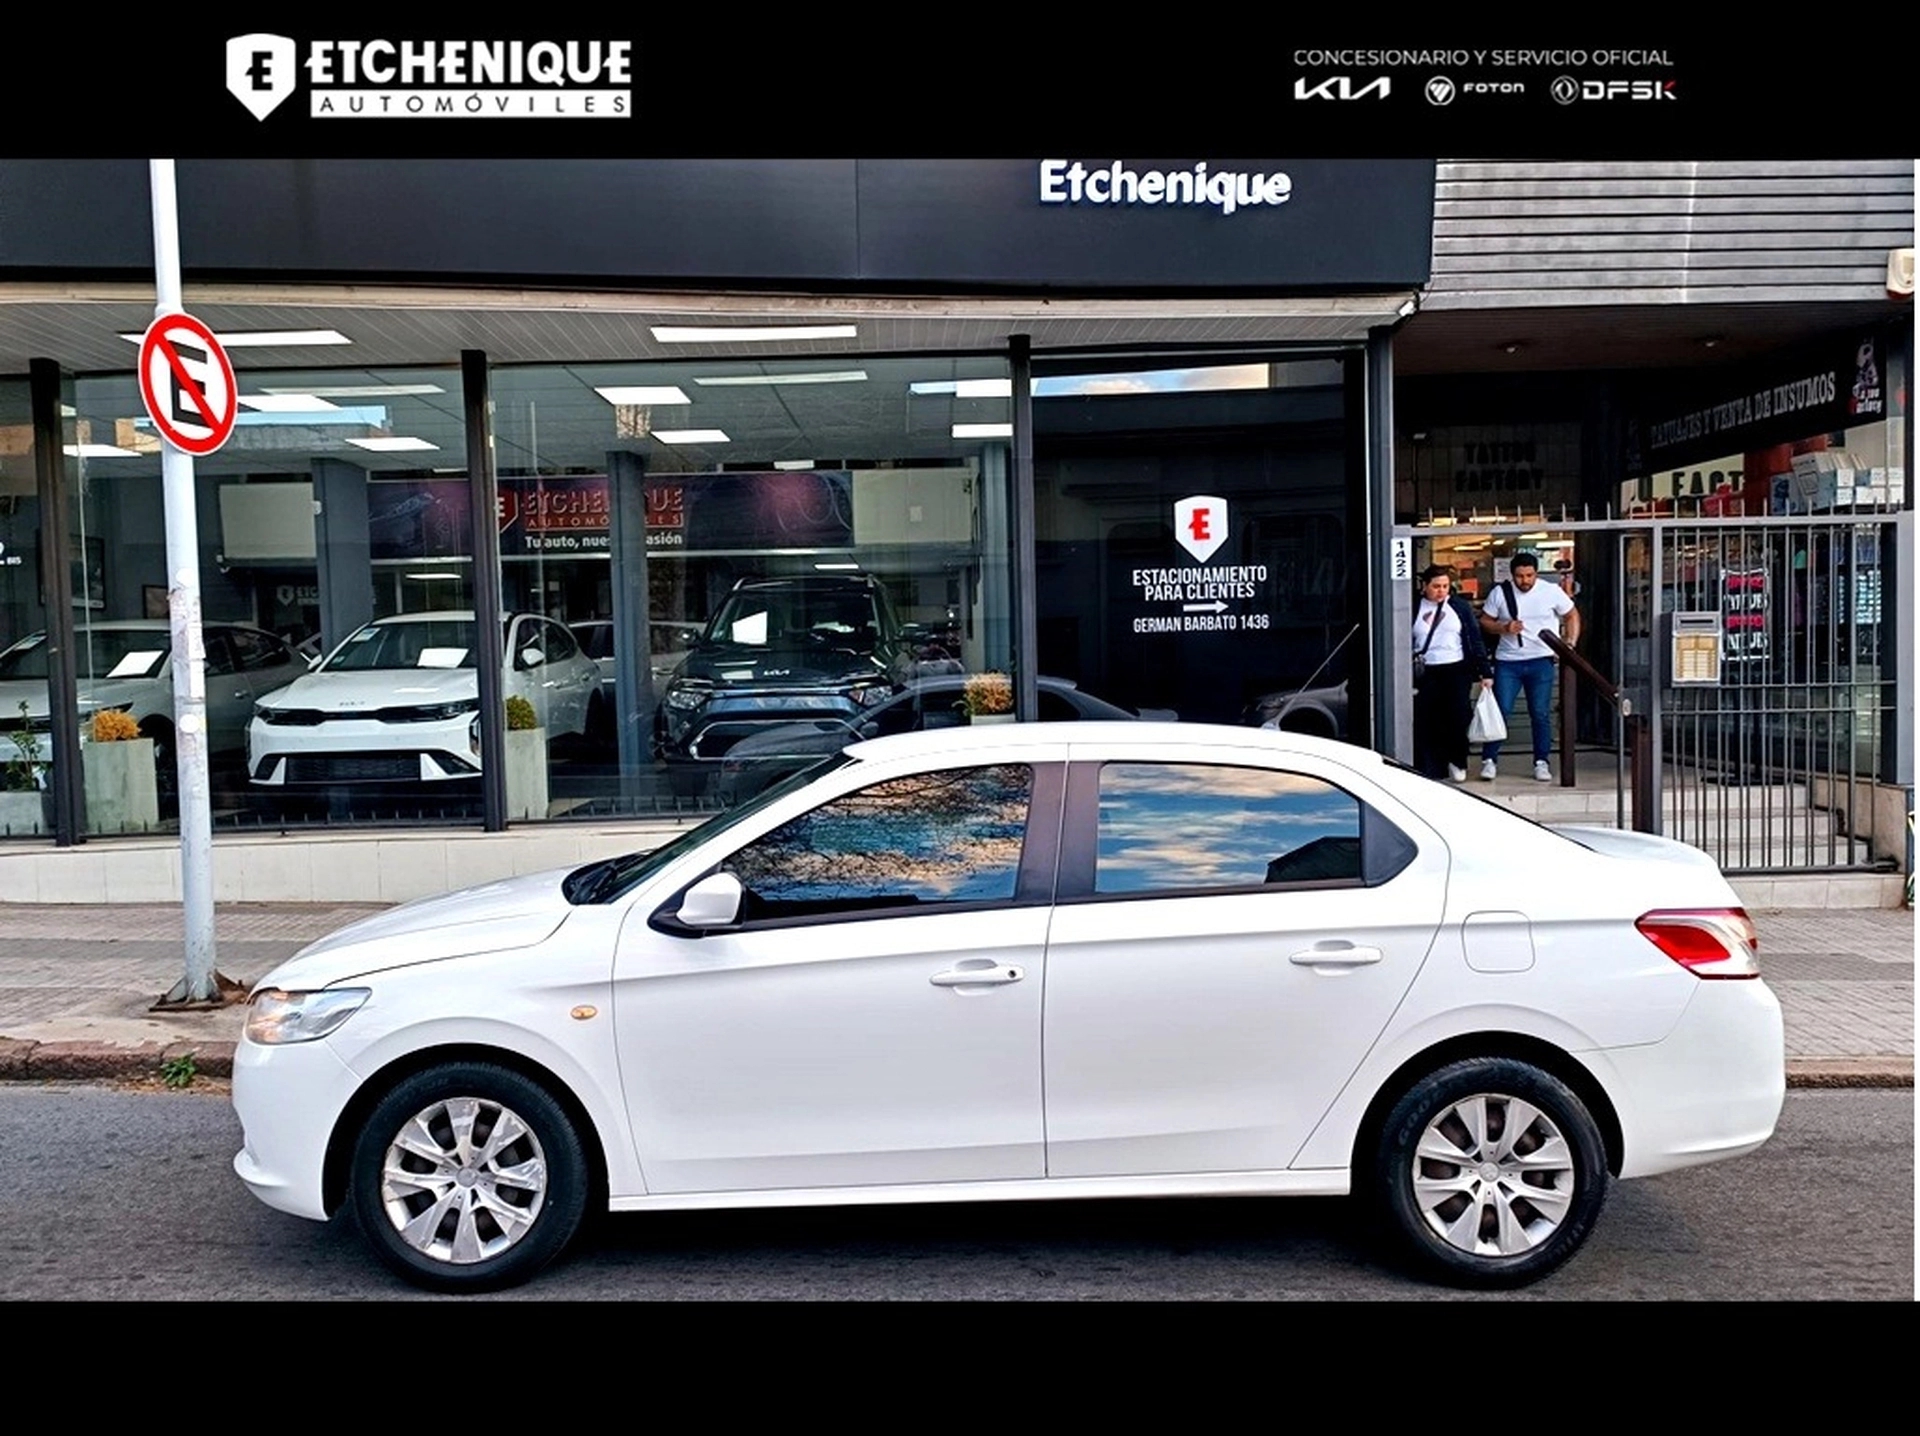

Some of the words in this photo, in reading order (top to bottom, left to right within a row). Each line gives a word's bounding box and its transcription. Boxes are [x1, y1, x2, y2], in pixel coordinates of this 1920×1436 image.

[1040, 159, 1292, 215] Etchenique
[1713, 396, 1752, 433] VENTA
[1754, 389, 1772, 420] DE
[1773, 370, 1836, 415] INSUMOS
[525, 536, 541, 548] Tu
[544, 535, 580, 549] auto,
[1395, 540, 1406, 577] 1422
[1132, 565, 1267, 586] ESTACIONAMIENTO
[1145, 584, 1183, 601] PARA
[1186, 582, 1255, 600] CLIENTES
[1133, 617, 1181, 633] GERMAN
[1184, 615, 1237, 632] BARBATO
[1240, 614, 1269, 630] 1436
